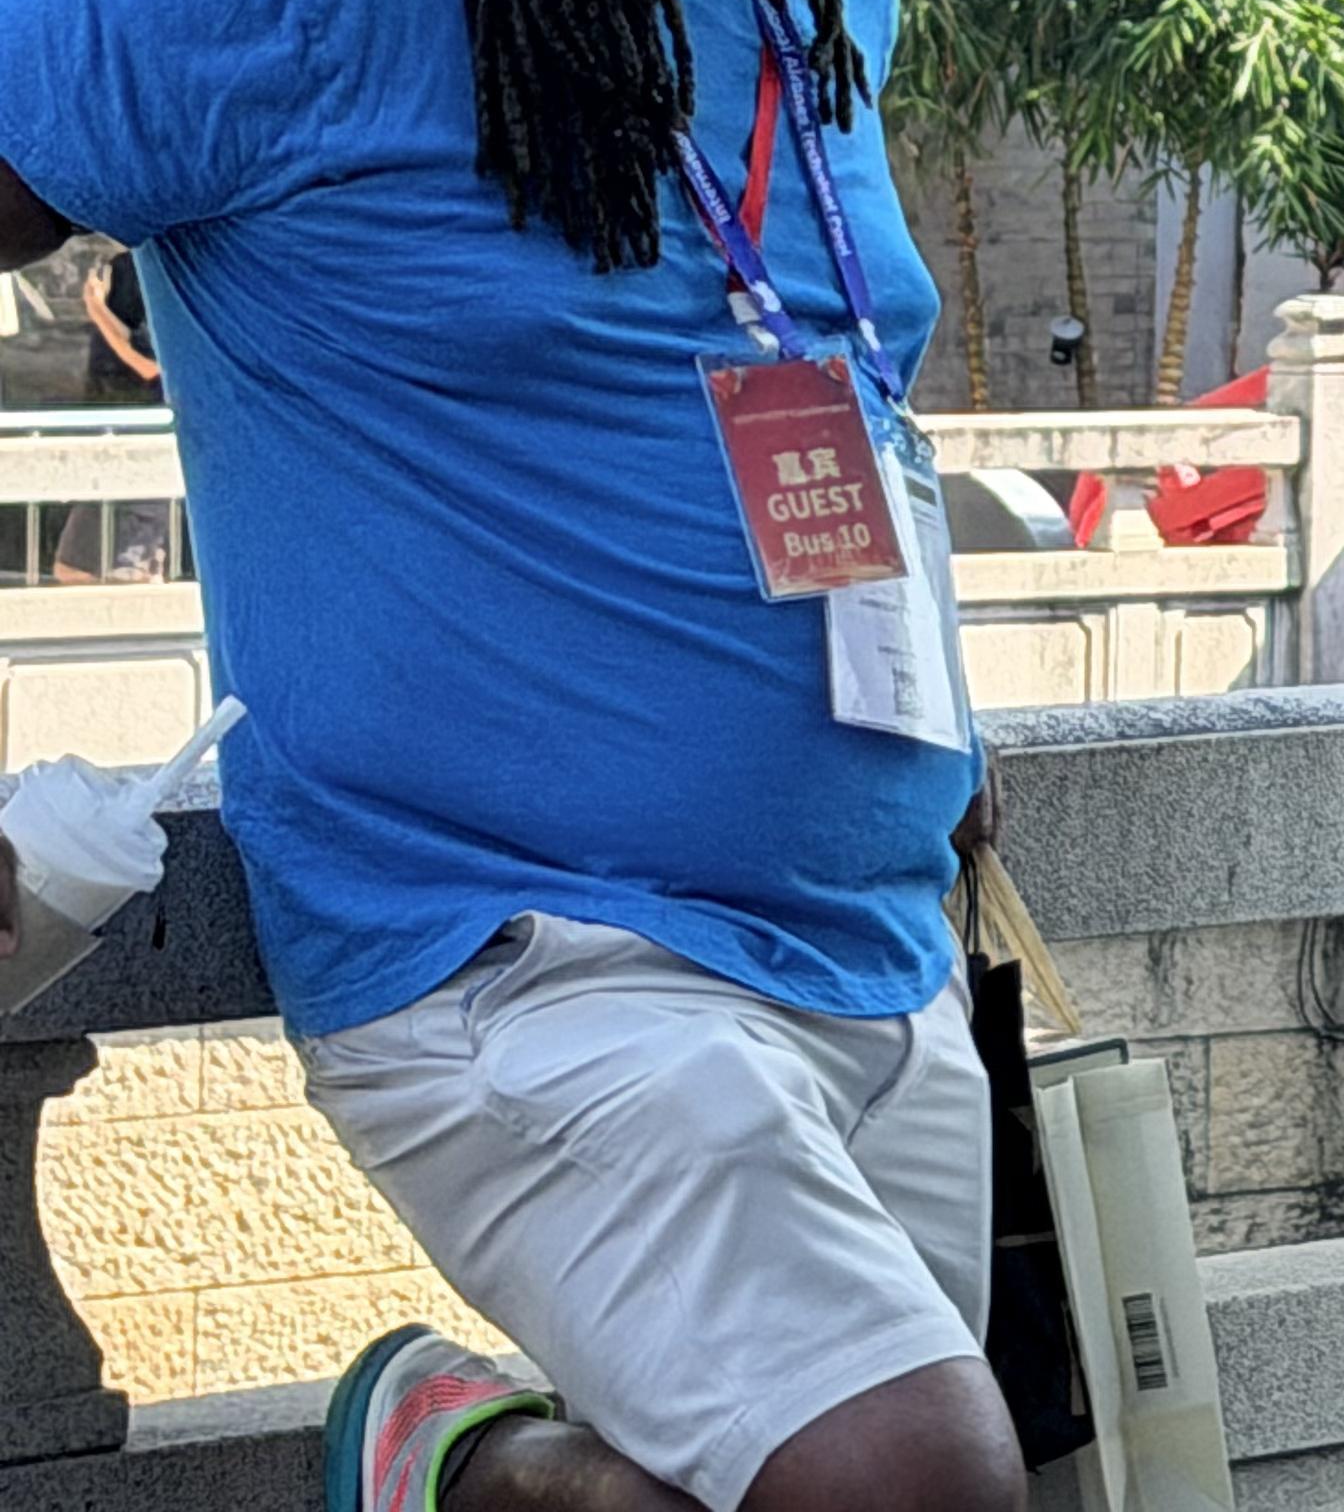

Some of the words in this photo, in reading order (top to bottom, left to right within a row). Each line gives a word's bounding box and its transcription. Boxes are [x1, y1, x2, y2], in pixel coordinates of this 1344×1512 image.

[767, 482, 864, 522] GUEST
[783, 530, 835, 558] Bus
[838, 521, 872, 550] 10
